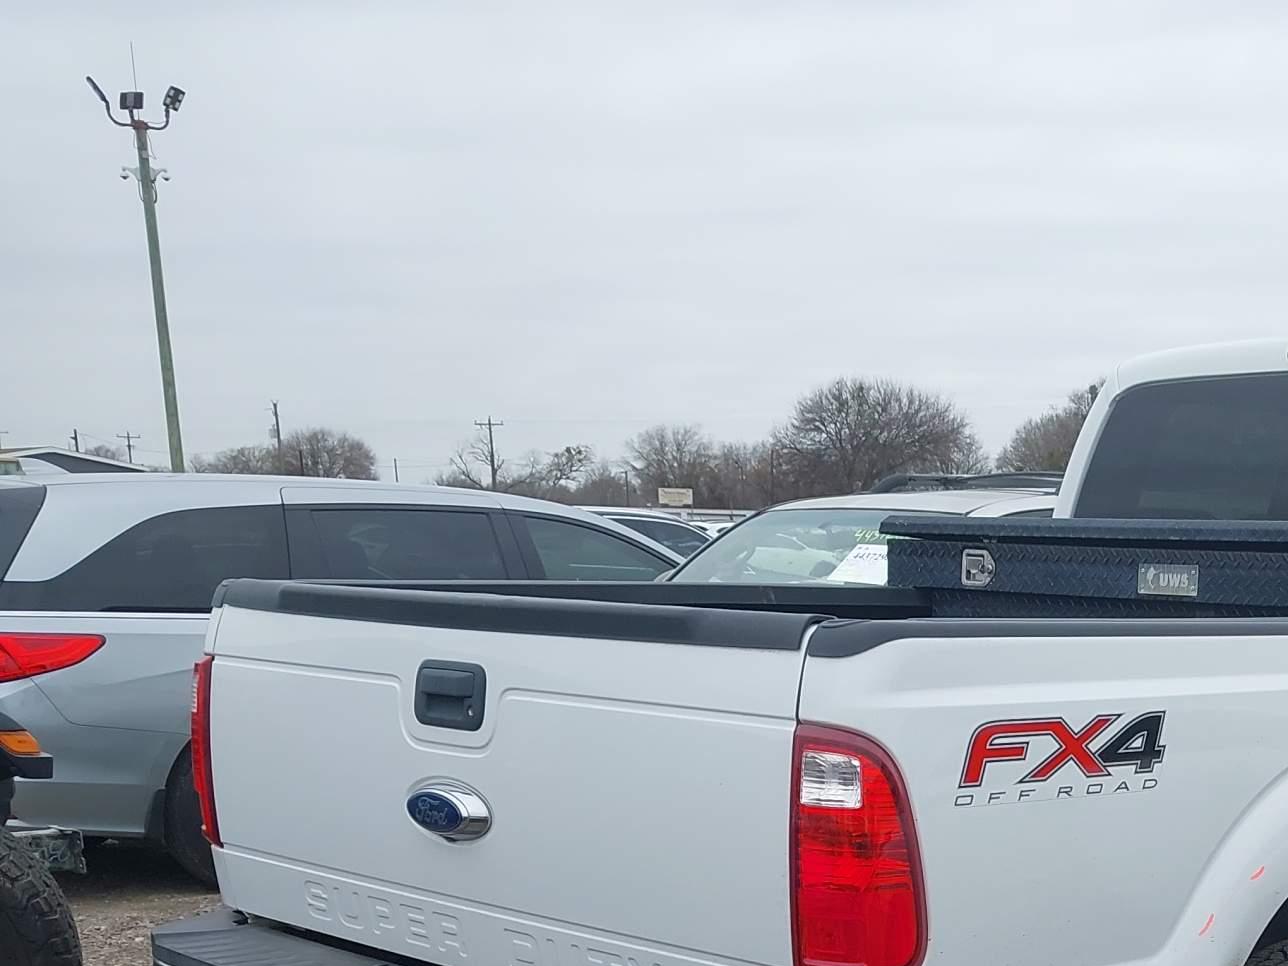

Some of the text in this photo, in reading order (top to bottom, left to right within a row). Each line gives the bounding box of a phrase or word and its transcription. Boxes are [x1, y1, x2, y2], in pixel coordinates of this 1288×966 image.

[1159, 572, 1189, 588] UWS
[957, 710, 1167, 788] FX4
[954, 778, 1158, 807] OFF ROAD
[415, 796, 448, 825] Ford
[303, 879, 468, 958] SUPER
